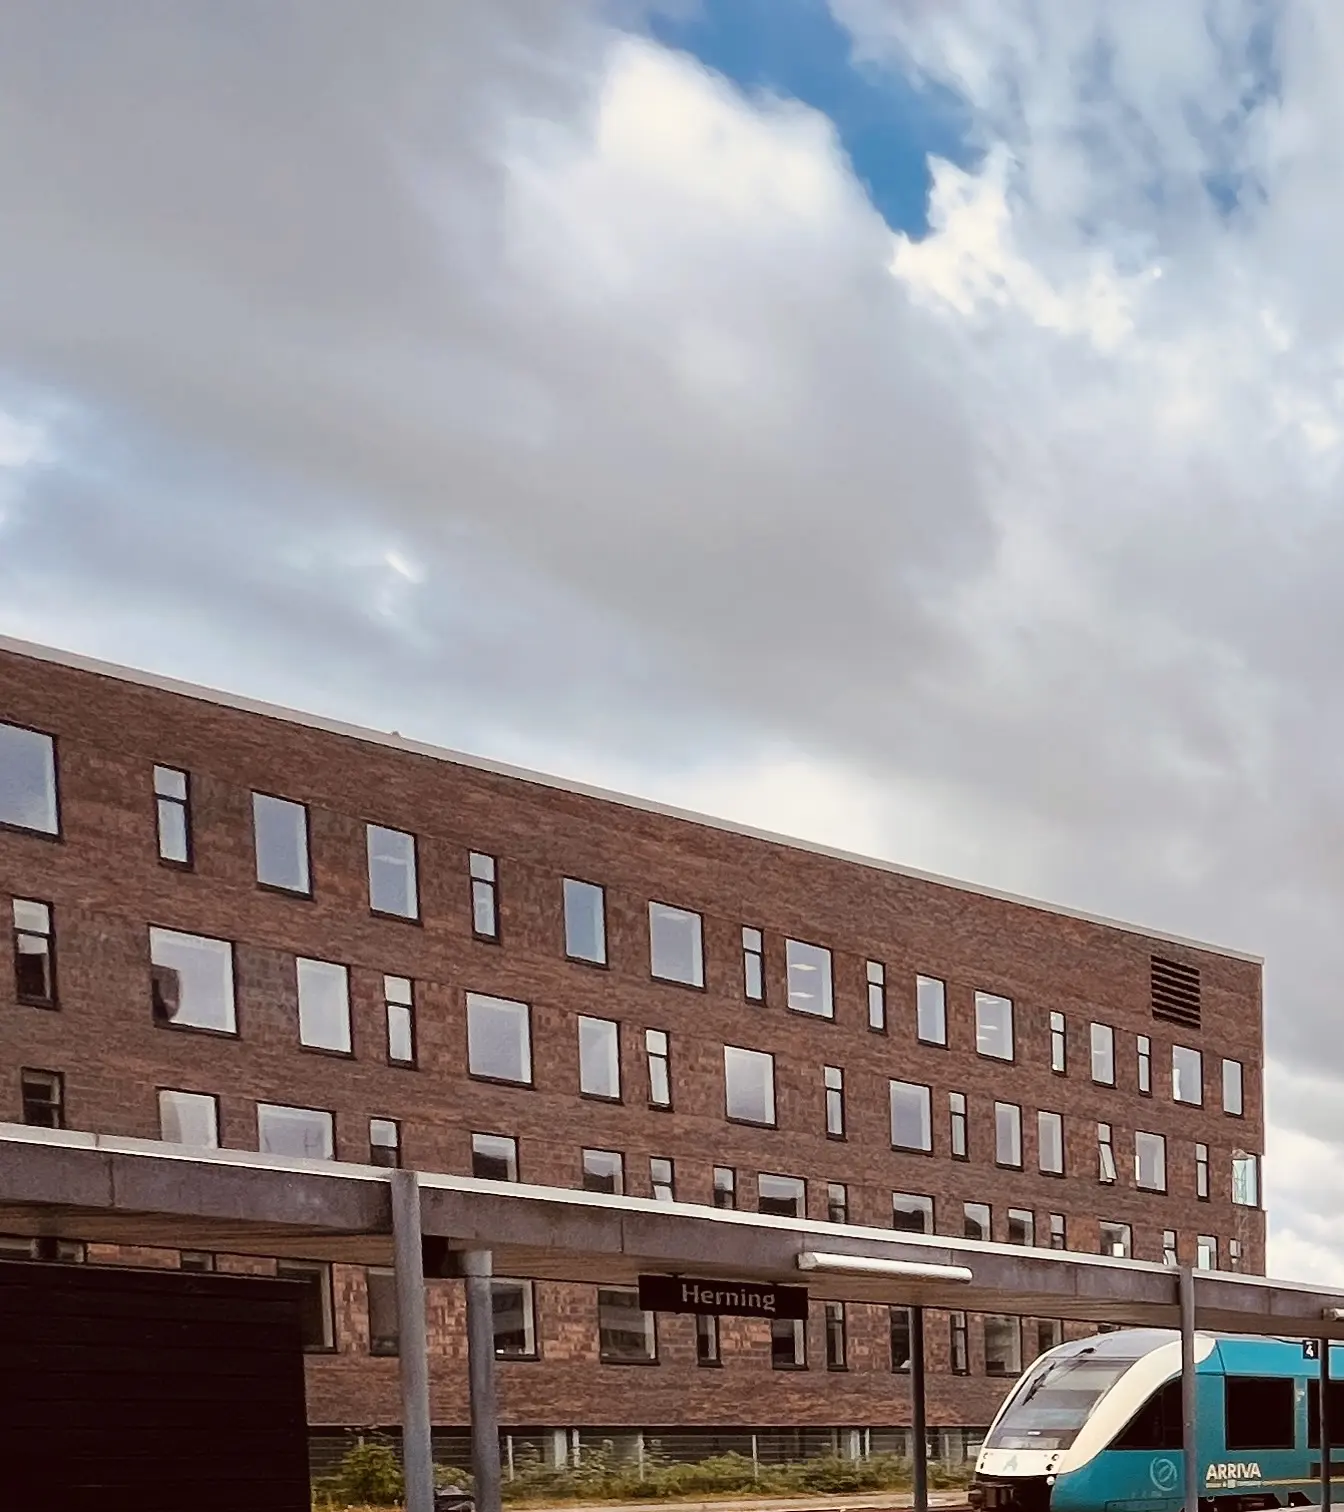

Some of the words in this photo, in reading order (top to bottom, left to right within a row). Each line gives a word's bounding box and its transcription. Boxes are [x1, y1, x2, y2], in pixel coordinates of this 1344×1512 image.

[681, 1283, 776, 1312] Herning
[1305, 1344, 1314, 1357] 4
[1205, 1462, 1262, 1481] ARRIVA
